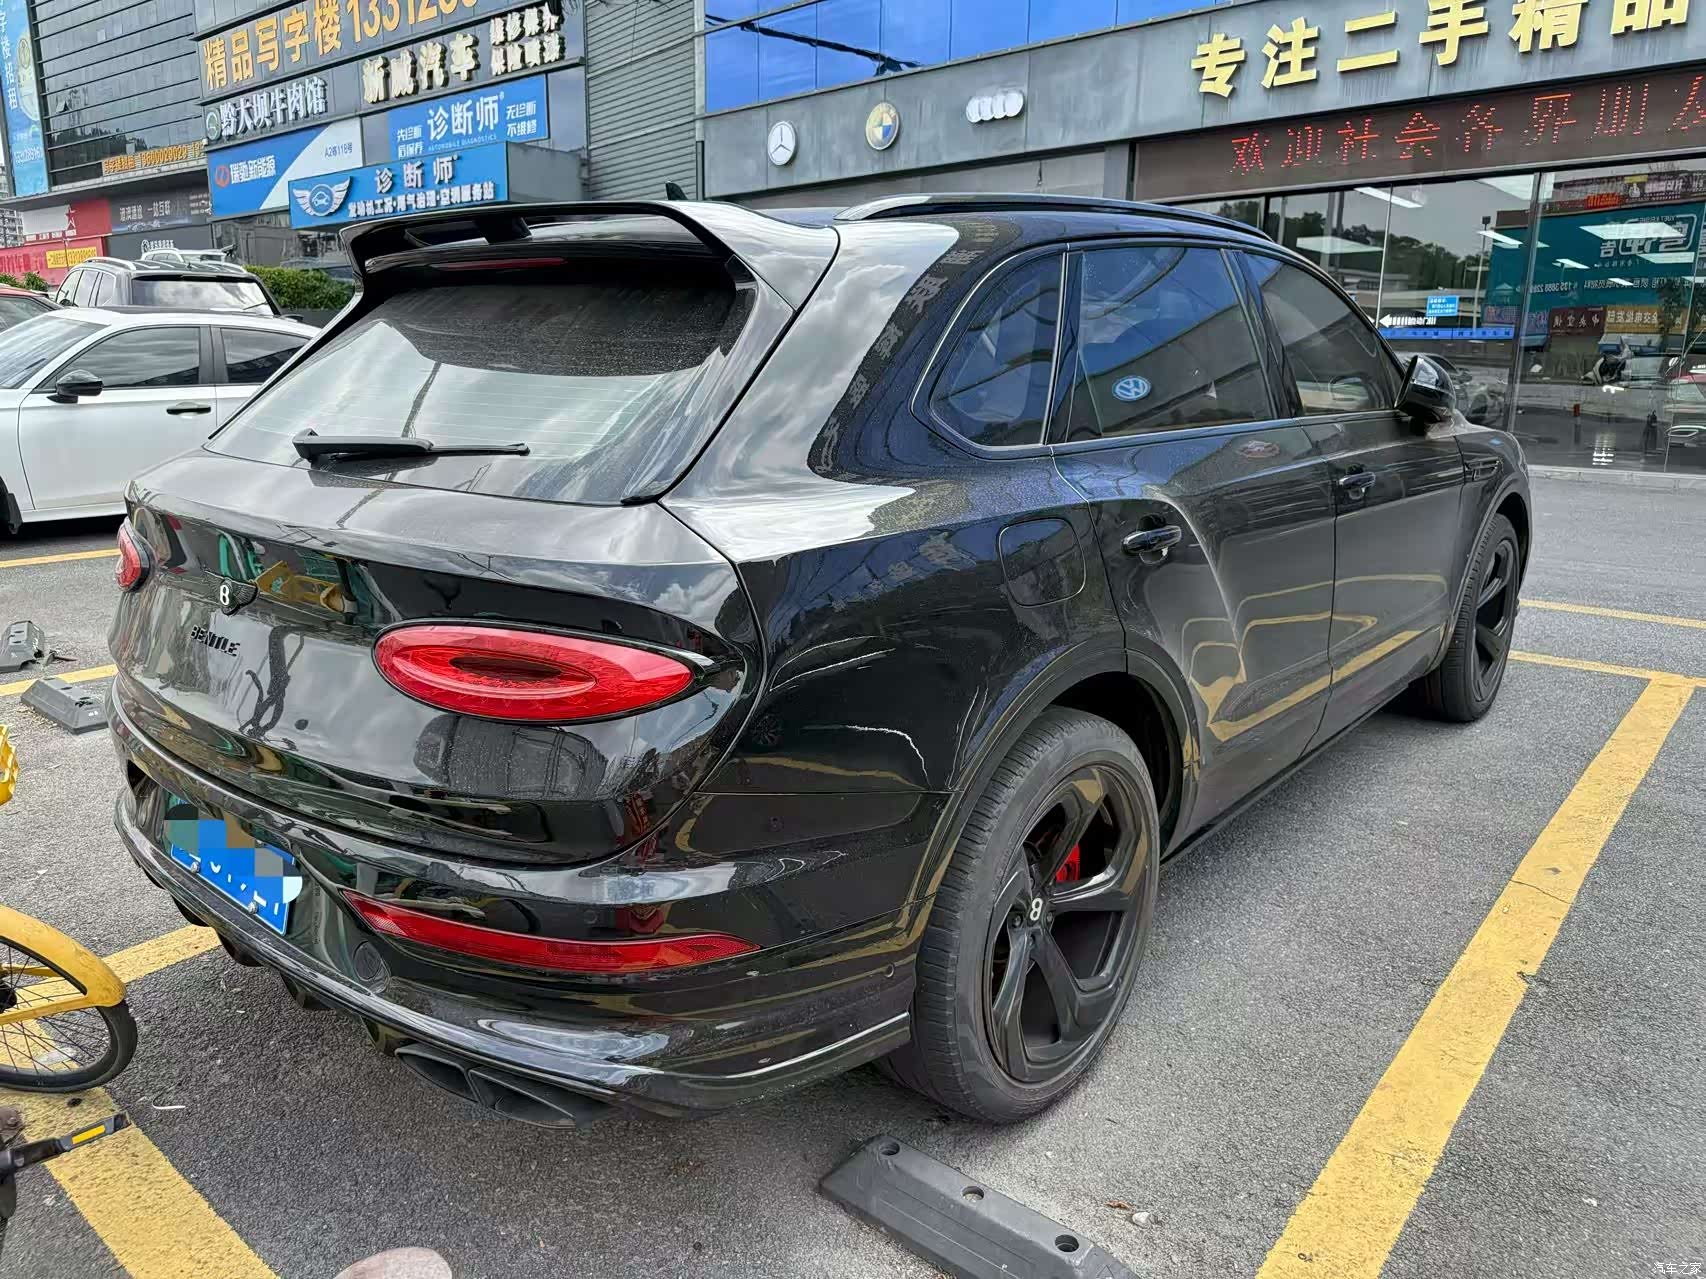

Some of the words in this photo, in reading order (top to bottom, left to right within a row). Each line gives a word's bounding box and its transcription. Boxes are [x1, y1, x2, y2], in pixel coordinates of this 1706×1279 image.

[203, 0, 341, 91] 精品写字楼
[1191, 0, 1690, 98] 专注二手精品
[427, 94, 500, 140] 诊断师
[374, 156, 455, 194] 诊断师
